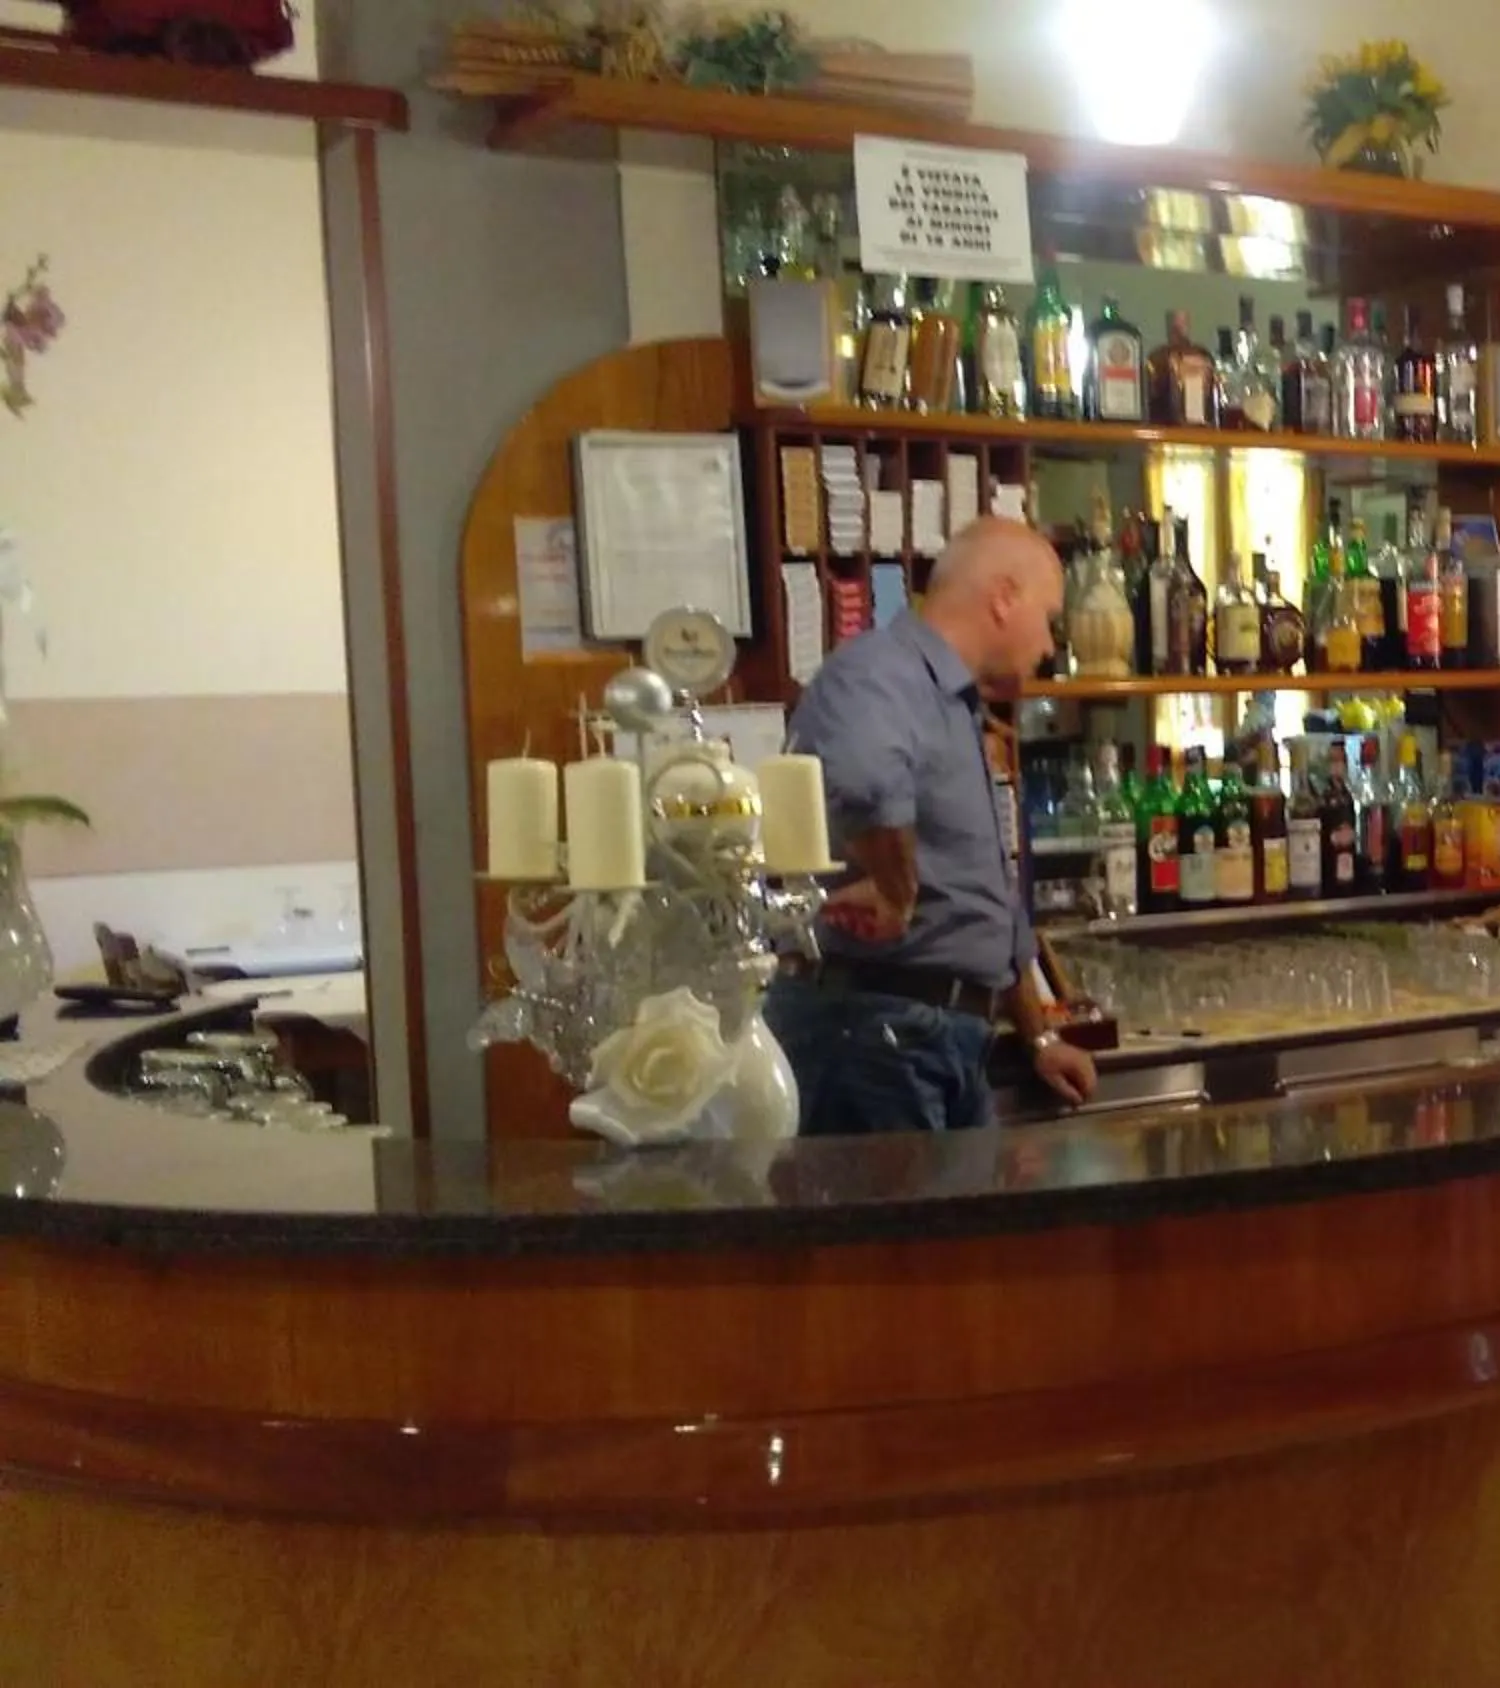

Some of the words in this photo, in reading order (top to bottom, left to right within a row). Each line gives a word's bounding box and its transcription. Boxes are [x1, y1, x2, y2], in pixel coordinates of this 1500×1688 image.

[917, 168, 981, 185] VIETATA
[895, 181, 914, 196] LA
[922, 186, 989, 203] VENDITA
[906, 215, 923, 228] AI
[930, 217, 990, 234] MINORI
[899, 230, 917, 244] DI
[951, 236, 991, 251] ANNI
